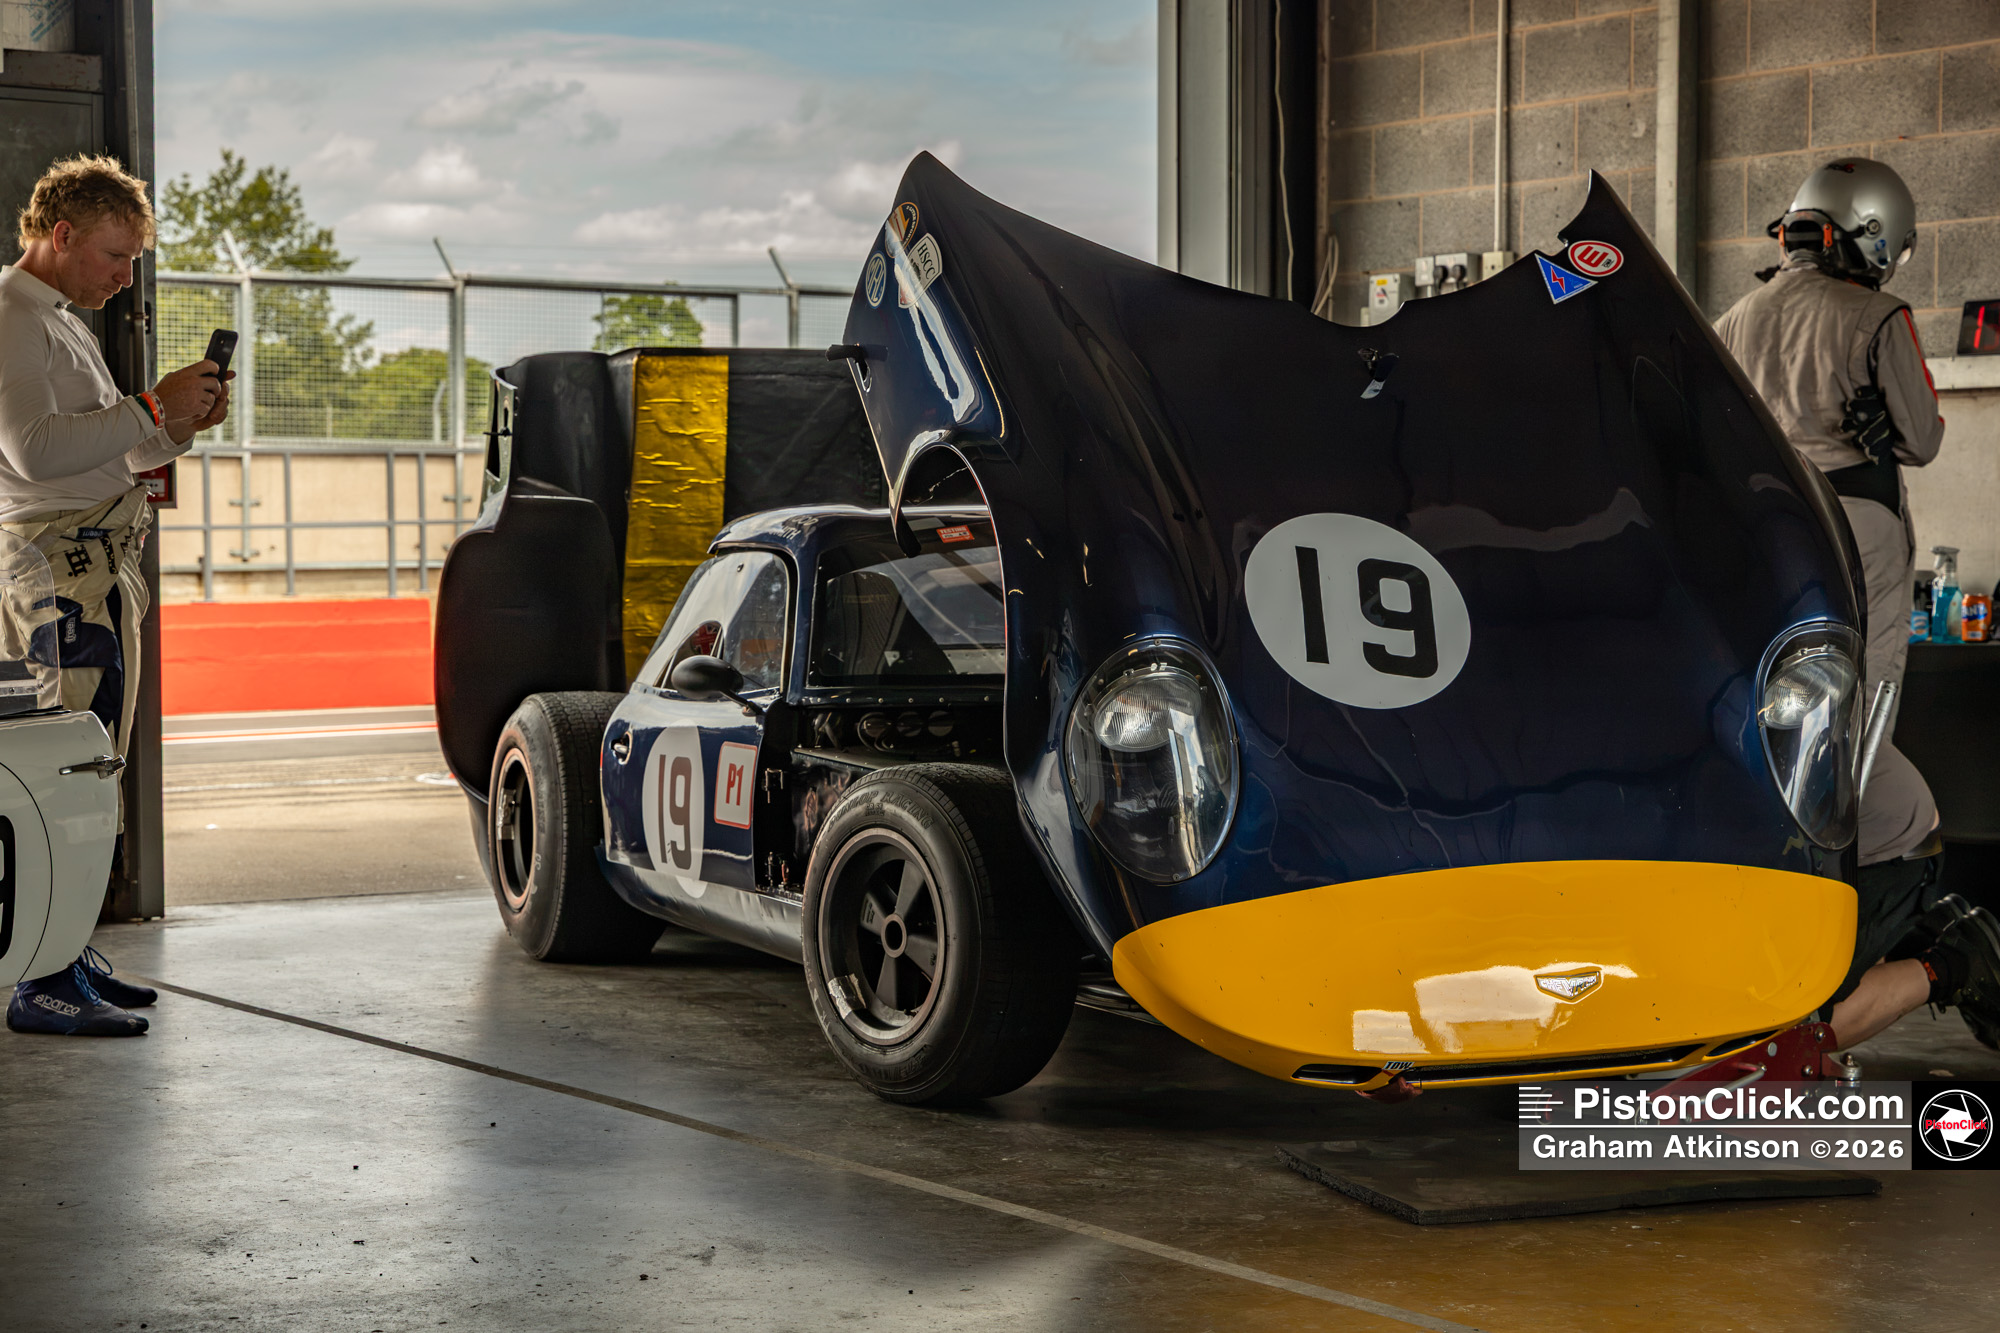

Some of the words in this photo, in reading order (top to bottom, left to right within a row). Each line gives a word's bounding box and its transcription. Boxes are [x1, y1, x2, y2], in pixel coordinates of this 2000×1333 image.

[917, 243, 936, 280] HSCC
[1295, 545, 1438, 679] 19
[725, 763, 744, 806] P1
[658, 754, 692, 870] 19
[881, 791, 935, 830] RACING
[35, 993, 81, 1016] sparco
[1384, 1061, 1414, 1070] TOW
